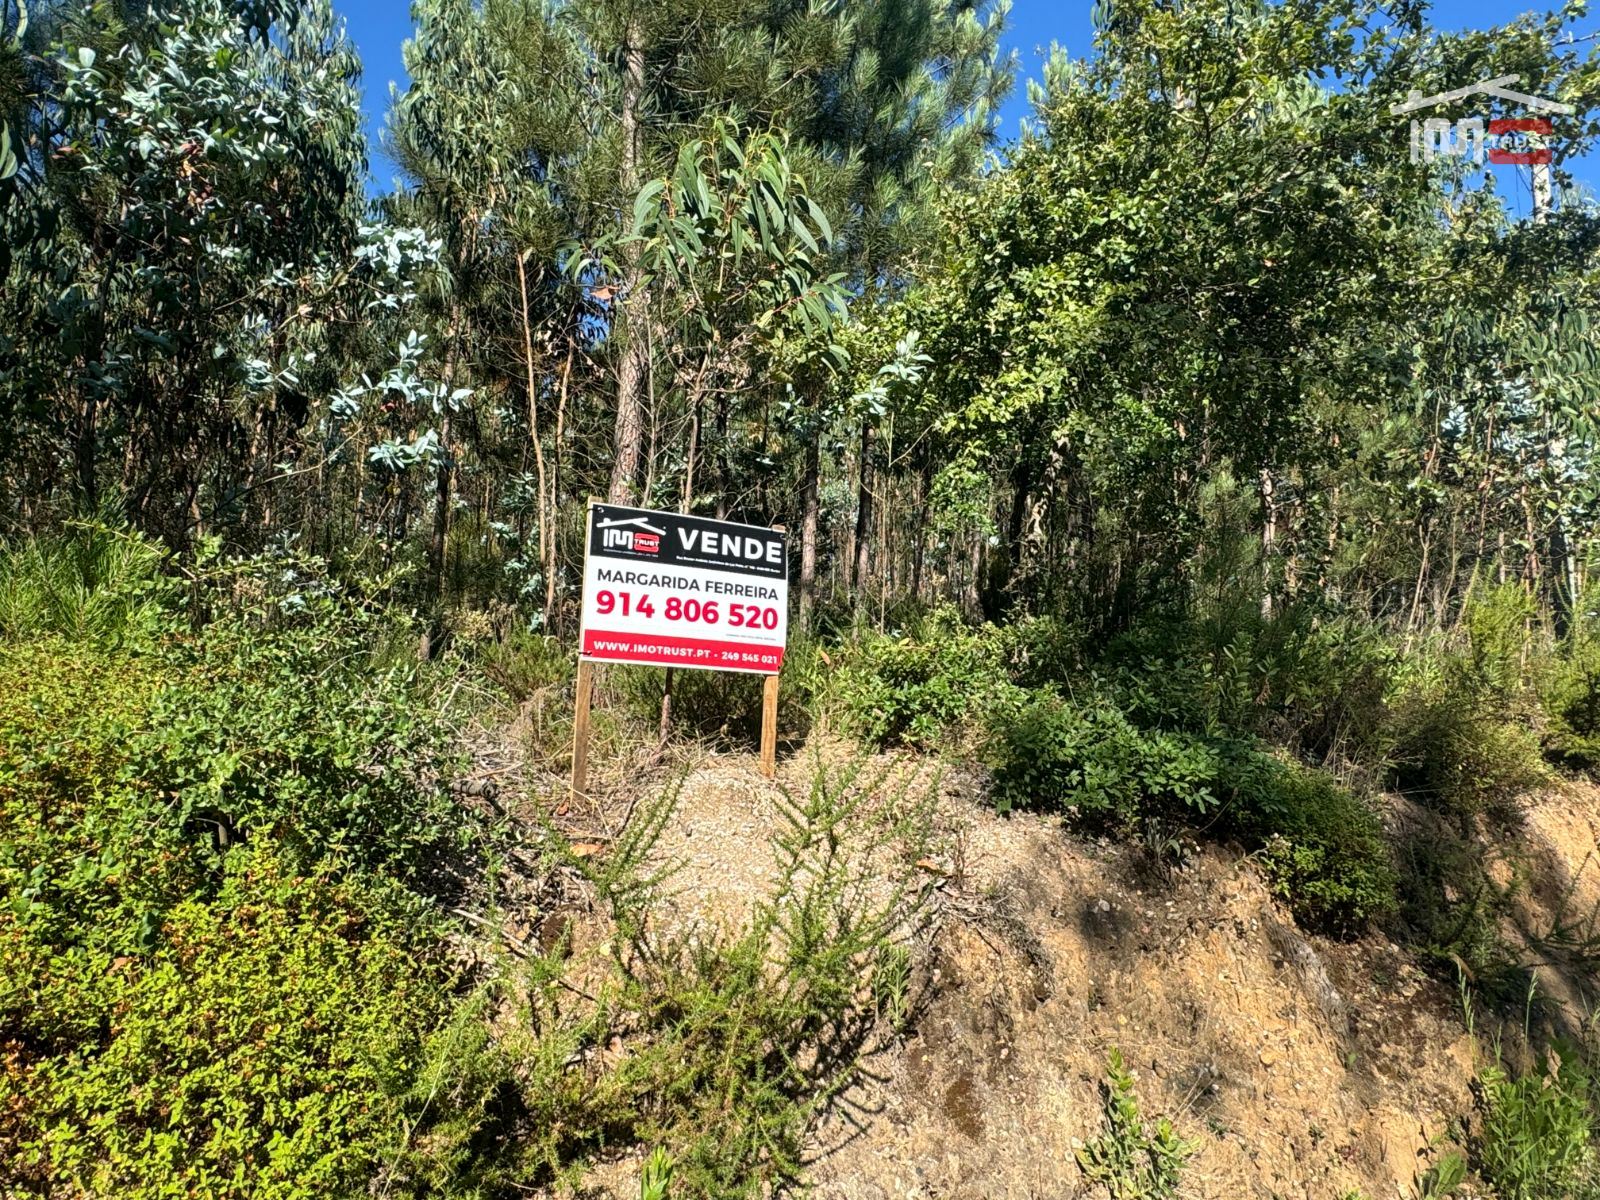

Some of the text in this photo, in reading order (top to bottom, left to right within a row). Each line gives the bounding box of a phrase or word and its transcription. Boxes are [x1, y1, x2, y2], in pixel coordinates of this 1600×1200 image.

[634, 538, 660, 547] TRUST
[677, 527, 782, 564] VENDE
[597, 568, 779, 601] MARGARIDA FERREIRA
[596, 590, 778, 630] 914 806 520
[593, 640, 711, 659] WWW.IMOTRUST.PT
[721, 651, 740, 661] 249
[742, 653, 759, 663] 545
[761, 654, 778, 665] 021
